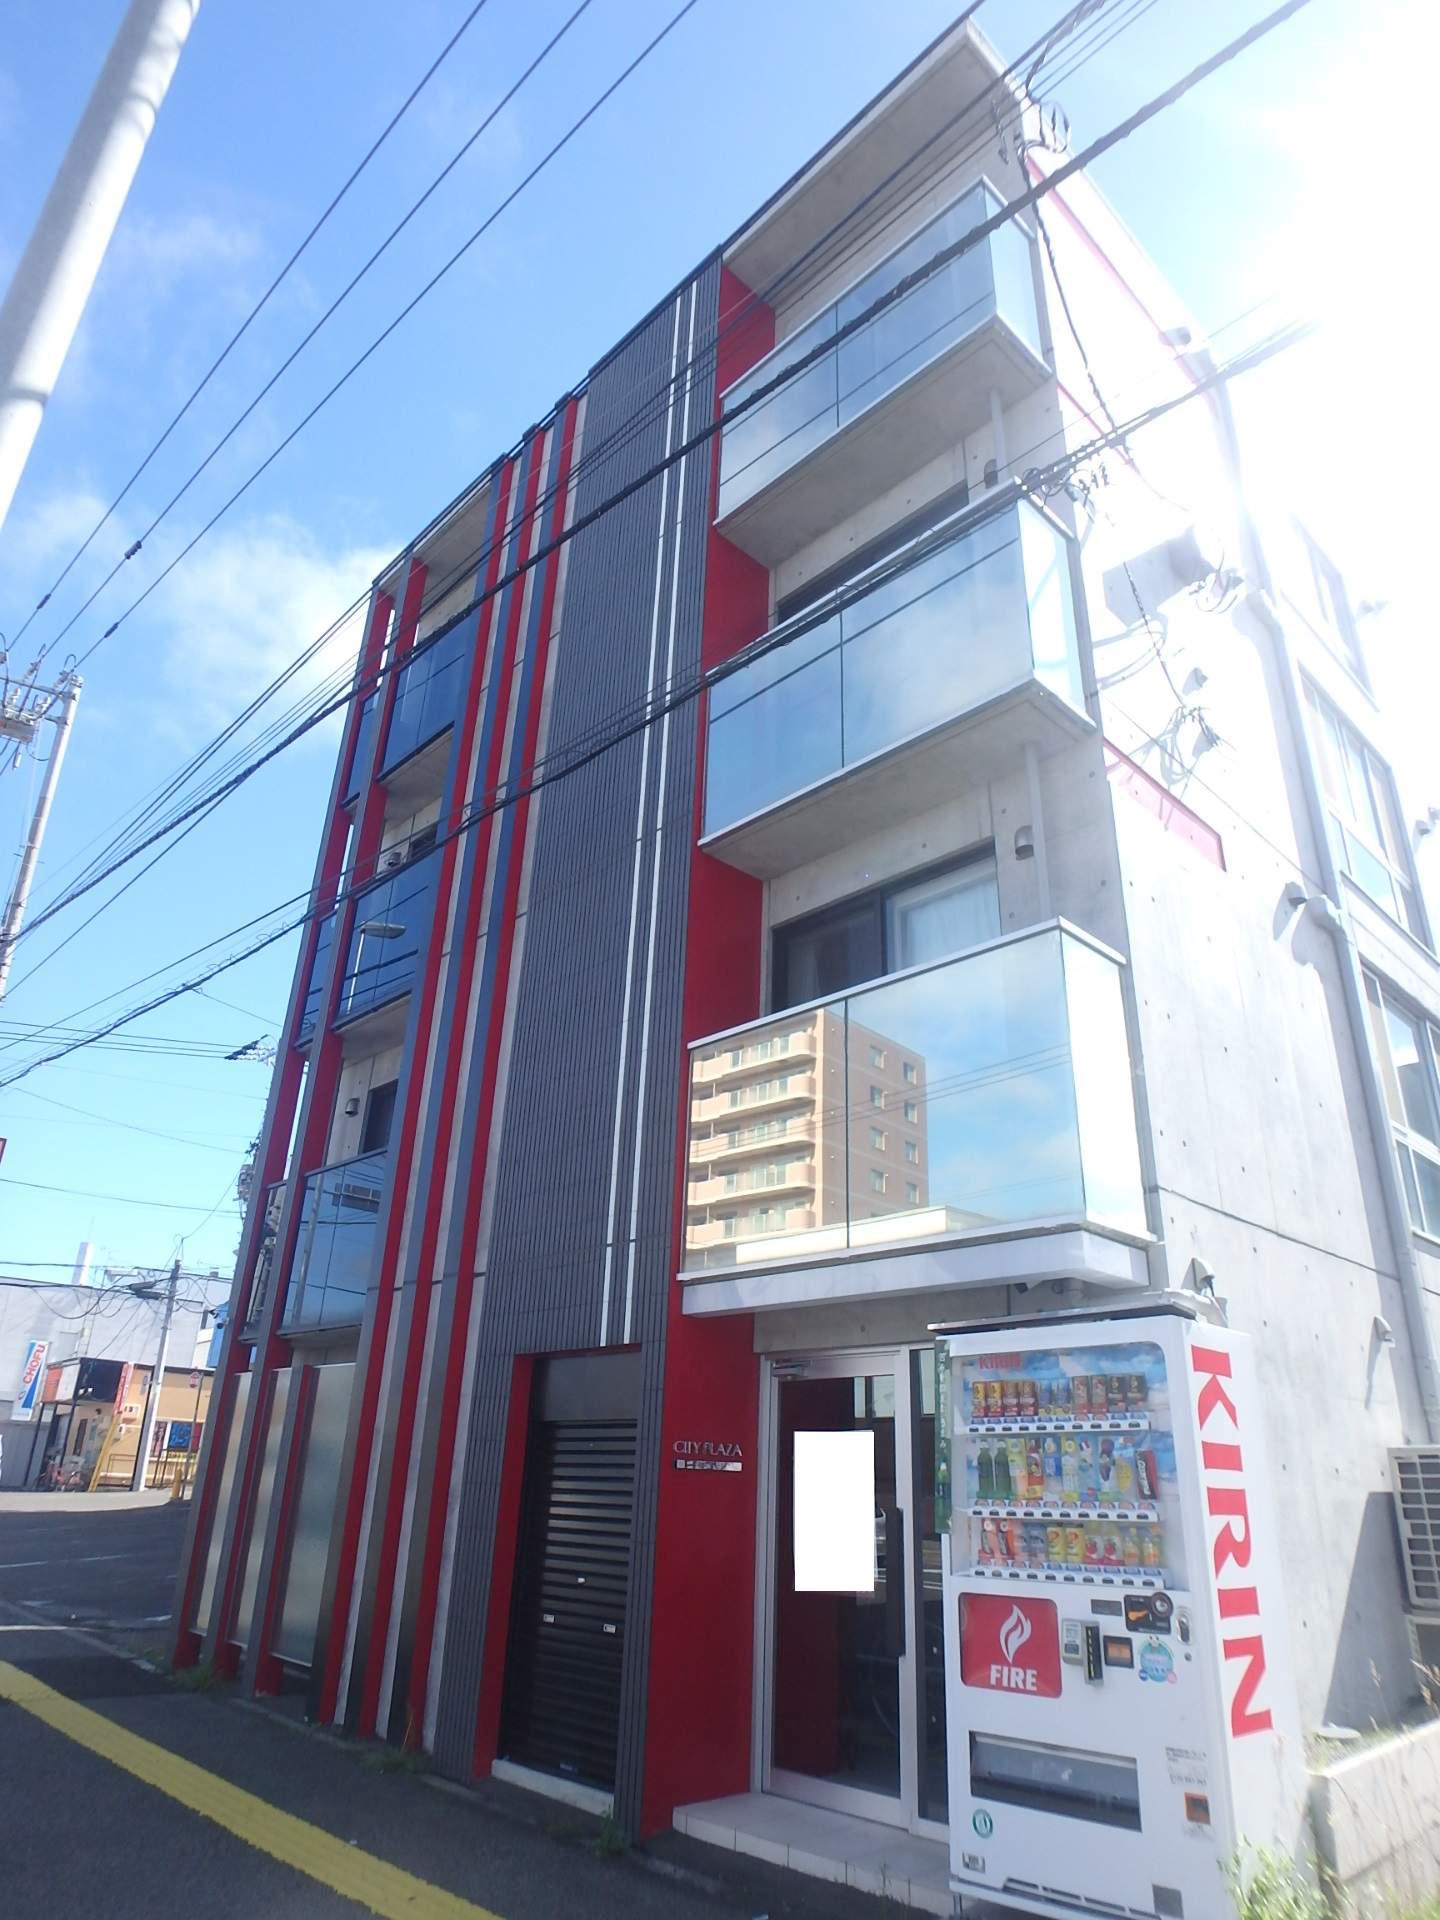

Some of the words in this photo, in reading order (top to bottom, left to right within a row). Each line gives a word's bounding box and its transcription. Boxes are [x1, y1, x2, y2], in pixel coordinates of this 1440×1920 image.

[23, 1344, 46, 1384] CHOFU
[674, 1440, 701, 1455] CITY
[1191, 1344, 1274, 1738] KIRIN
[990, 1664, 1038, 1691] FIRE
